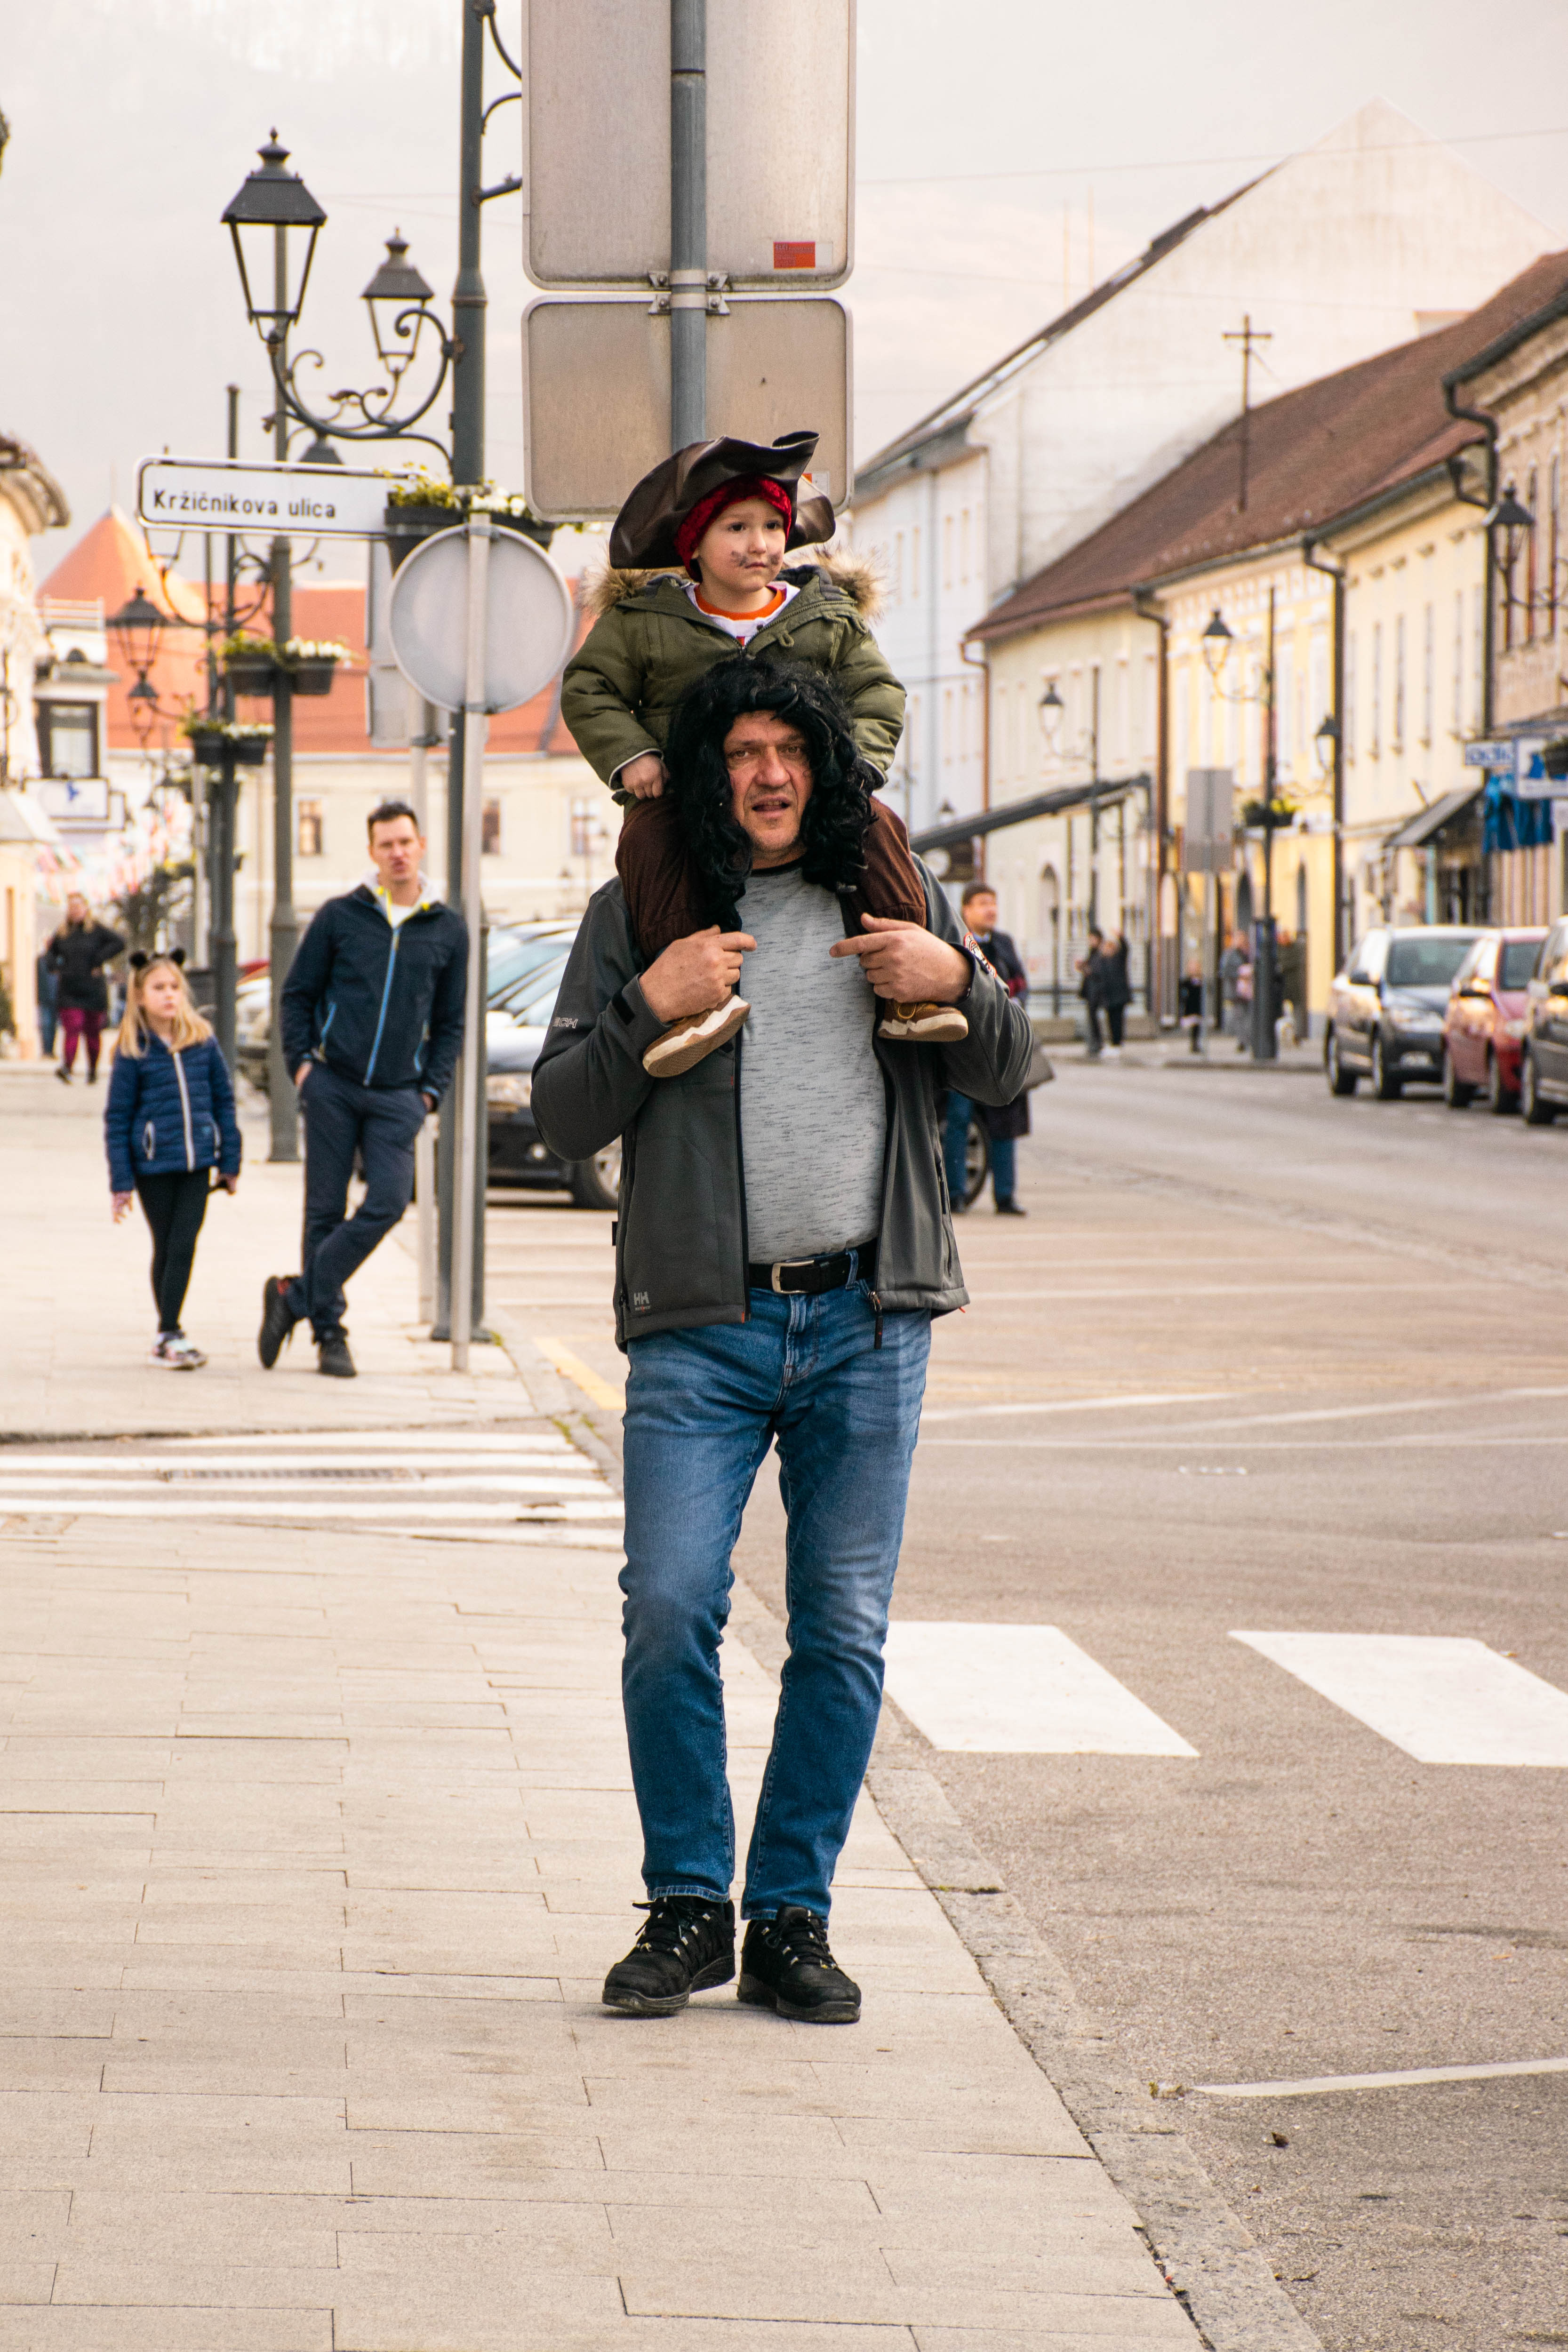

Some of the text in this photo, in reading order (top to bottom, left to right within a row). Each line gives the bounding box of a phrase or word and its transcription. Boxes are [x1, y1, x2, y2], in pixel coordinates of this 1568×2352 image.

[153, 488, 336, 518] Kržičnikova ulica
[633, 1291, 650, 1305] HH
